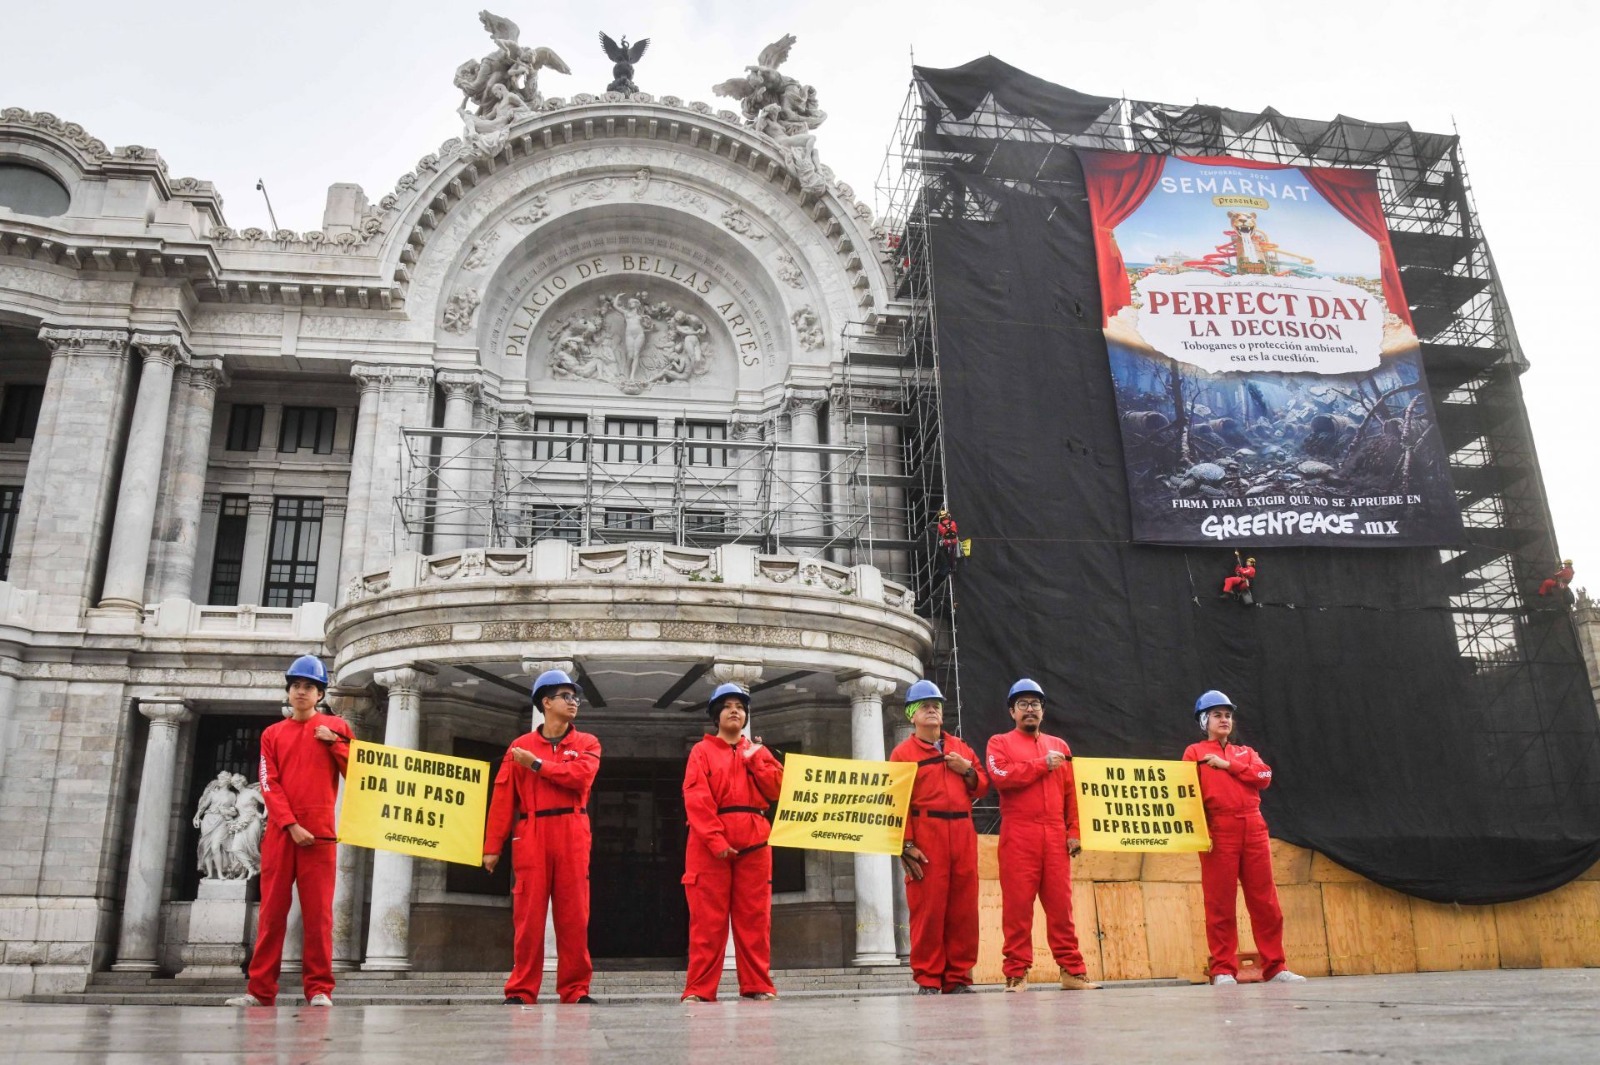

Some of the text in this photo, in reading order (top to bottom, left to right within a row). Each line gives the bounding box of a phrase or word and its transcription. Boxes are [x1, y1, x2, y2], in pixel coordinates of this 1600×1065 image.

[1161, 177, 1310, 202] SEMARNAT
[1218, 197, 1263, 207] Presenta:
[506, 256, 760, 367] PALACIO DE BELLAS ARTES
[1148, 291, 1368, 321] PERFECT DAY
[1189, 319, 1342, 340] LA DECISIÓN
[1181, 341, 1237, 352] Toboganes
[1248, 341, 1302, 353] protección
[1304, 343, 1358, 356] ambiental,
[1260, 352, 1270, 362] la
[1272, 353, 1319, 363] cuestión.
[1172, 494, 1421, 509] FIRMA PARA EXIGIR QUE NO SE APRUEBE EN
[356, 748, 481, 784] ROYAL CARIBBEAN
[1106, 766, 1166, 781] NO MÁS
[804, 768, 893, 787] SEMARNAT:
[360, 775, 465, 806] ¡DA UN PASO
[793, 790, 896, 808] MÁS PROTECCIÓN,
[1081, 782, 1196, 799] PROYECTOS DE
[381, 804, 444, 829] ATRÁS!
[1105, 802, 1175, 817] TURISMO
[779, 809, 903, 828] MENOS DESTRUCCIÓN
[1092, 818, 1194, 834] DEPREDADOR
[384, 832, 440, 848] GREENPEACE
[811, 830, 863, 842] GREENPEACE
[1120, 838, 1170, 846] GREENPEACE
